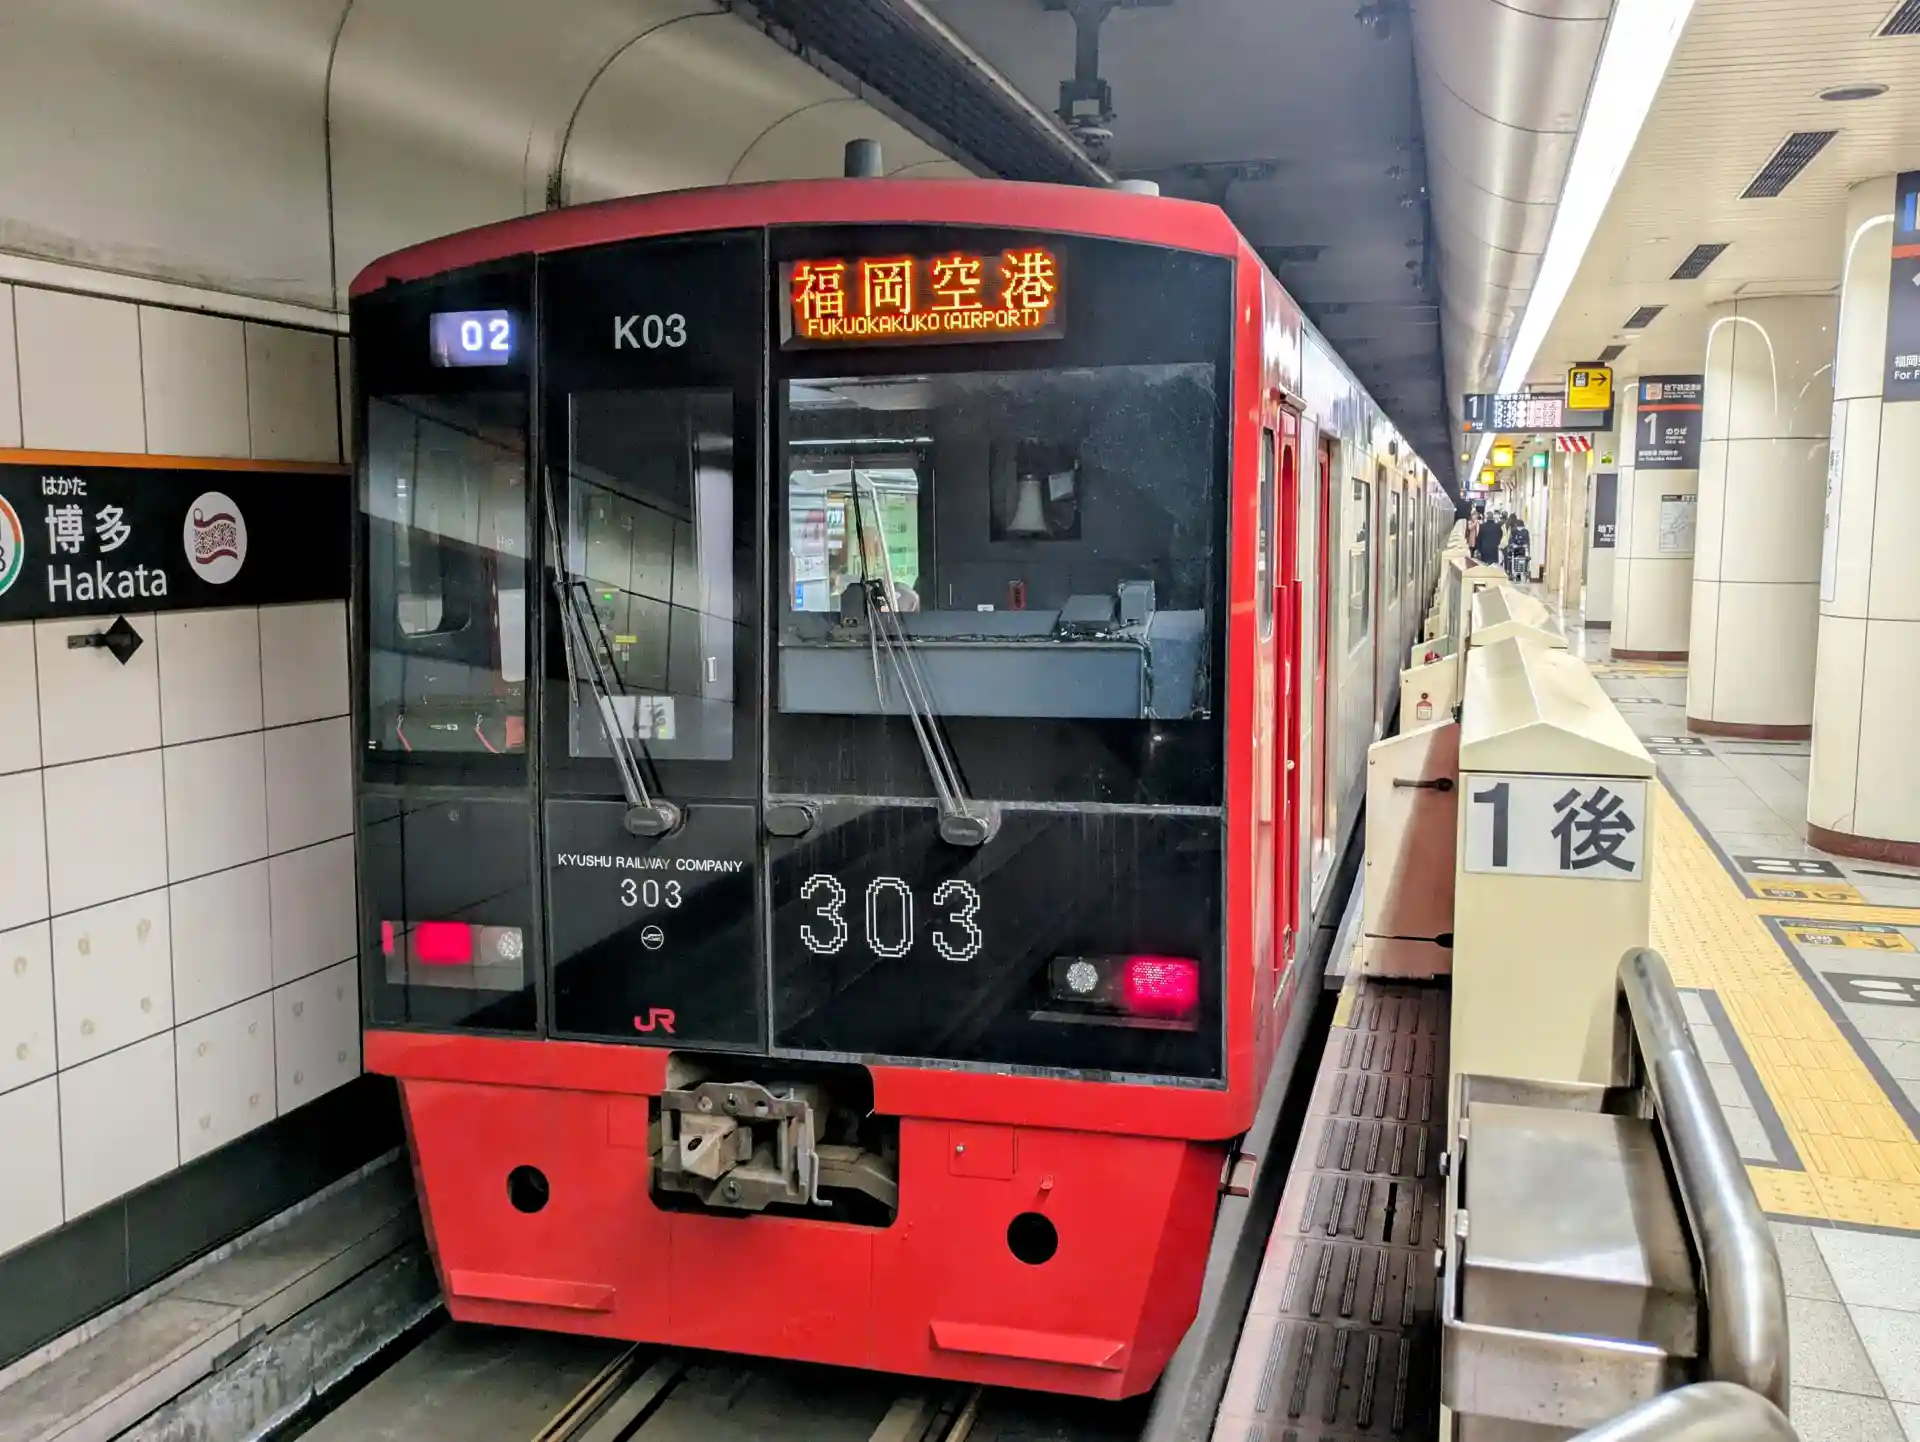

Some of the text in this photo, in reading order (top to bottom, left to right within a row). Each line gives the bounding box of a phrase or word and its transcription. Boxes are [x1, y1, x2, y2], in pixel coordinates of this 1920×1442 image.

[796, 252, 1054, 319] 福岡空港
[461, 318, 509, 351] 02
[614, 313, 686, 349] K03
[1894, 355, 1920, 368] 福岡
[1894, 370, 1912, 380] For
[1468, 396, 1478, 418] 1
[1644, 412, 1658, 445] 1
[41, 475, 88, 496] はかた
[45, 503, 131, 554] 博多
[48, 560, 168, 602] Hakata
[1474, 782, 1636, 873] 1 後
[557, 854, 743, 873] KYUSHU RAILWAY COMPANY
[620, 878, 682, 909] 303
[801, 874, 982, 962] 303
[633, 1008, 676, 1033] JR
